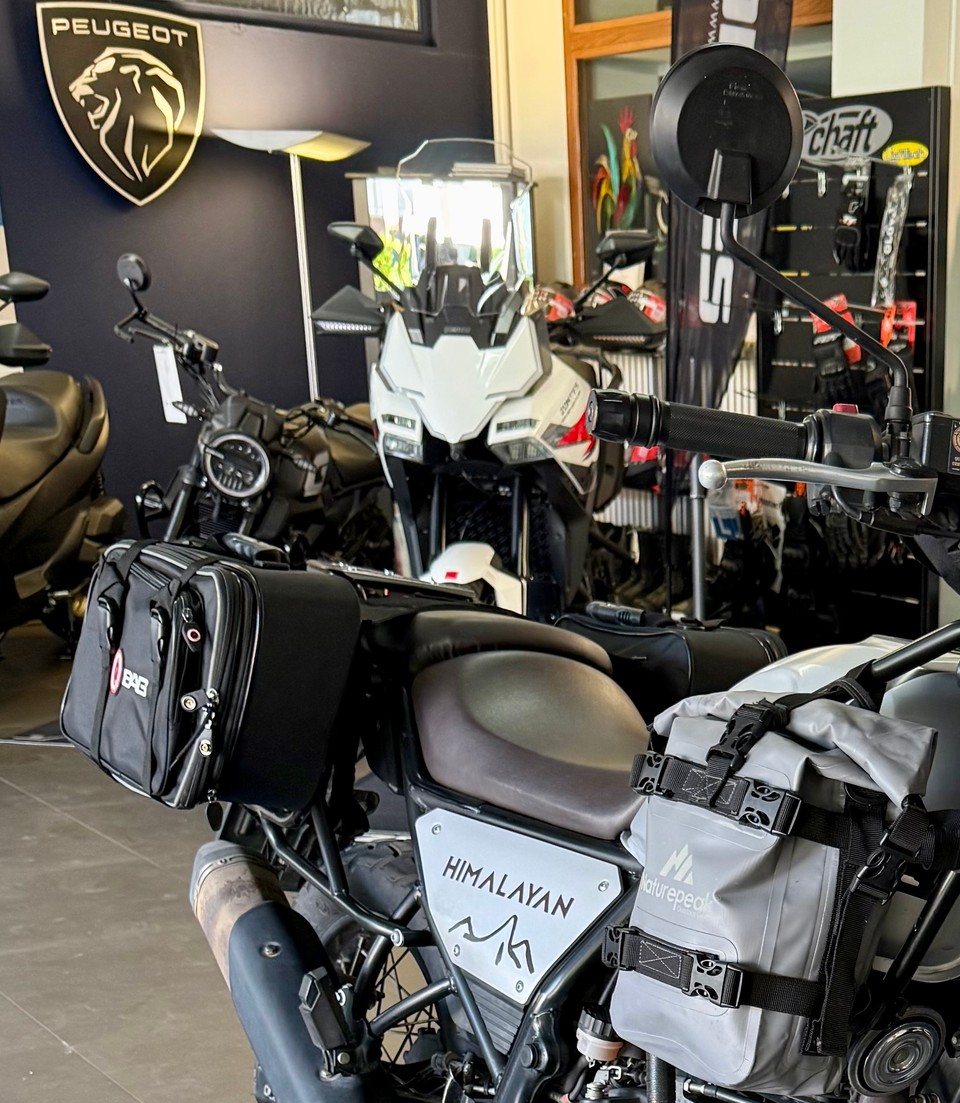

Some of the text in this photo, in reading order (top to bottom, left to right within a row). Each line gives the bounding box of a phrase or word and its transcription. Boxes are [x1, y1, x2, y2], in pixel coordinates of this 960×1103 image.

[52, 17, 189, 46] PEUGEOT
[807, 109, 878, 157] chaft
[442, 855, 575, 919] HIMALAYAN
